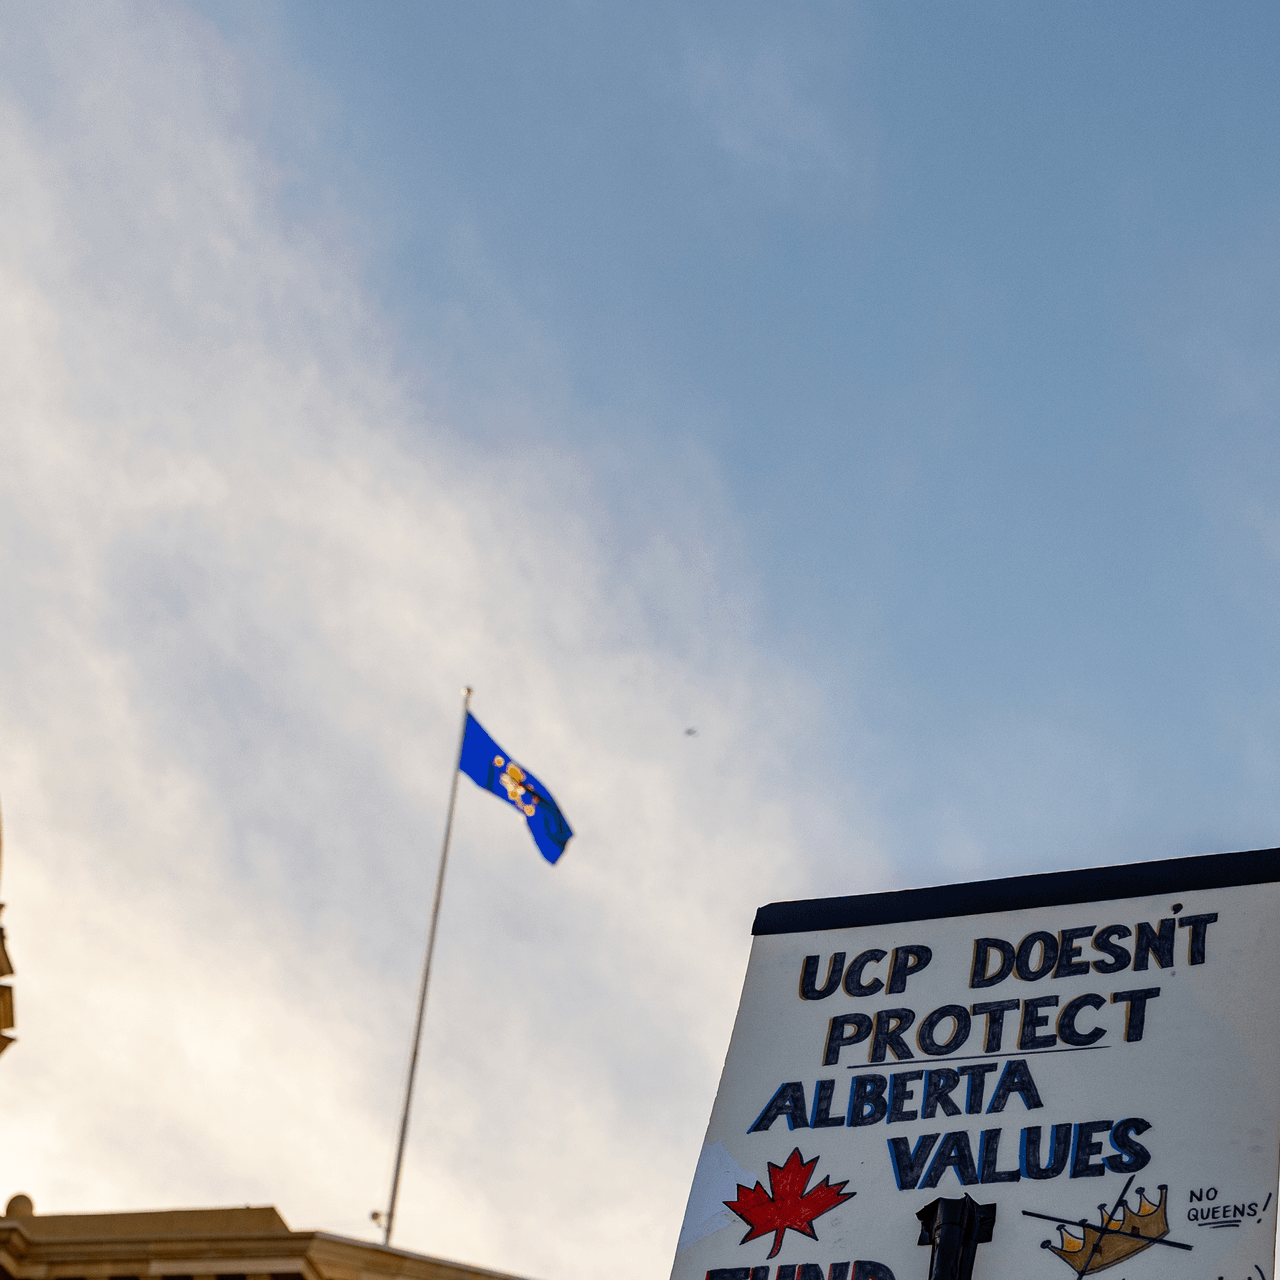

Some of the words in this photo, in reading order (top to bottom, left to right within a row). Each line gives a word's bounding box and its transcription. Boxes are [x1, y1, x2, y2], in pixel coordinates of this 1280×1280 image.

[799, 944, 933, 1001] UCP
[969, 903, 1219, 989] DOESN'T
[822, 986, 1161, 1067] PROTECT
[746, 1058, 1045, 1134] ALBERTA
[887, 1117, 1153, 1191] VALUES
[1187, 1192, 1273, 1224] QUEENS!
[1188, 1187, 1219, 1203] NO
